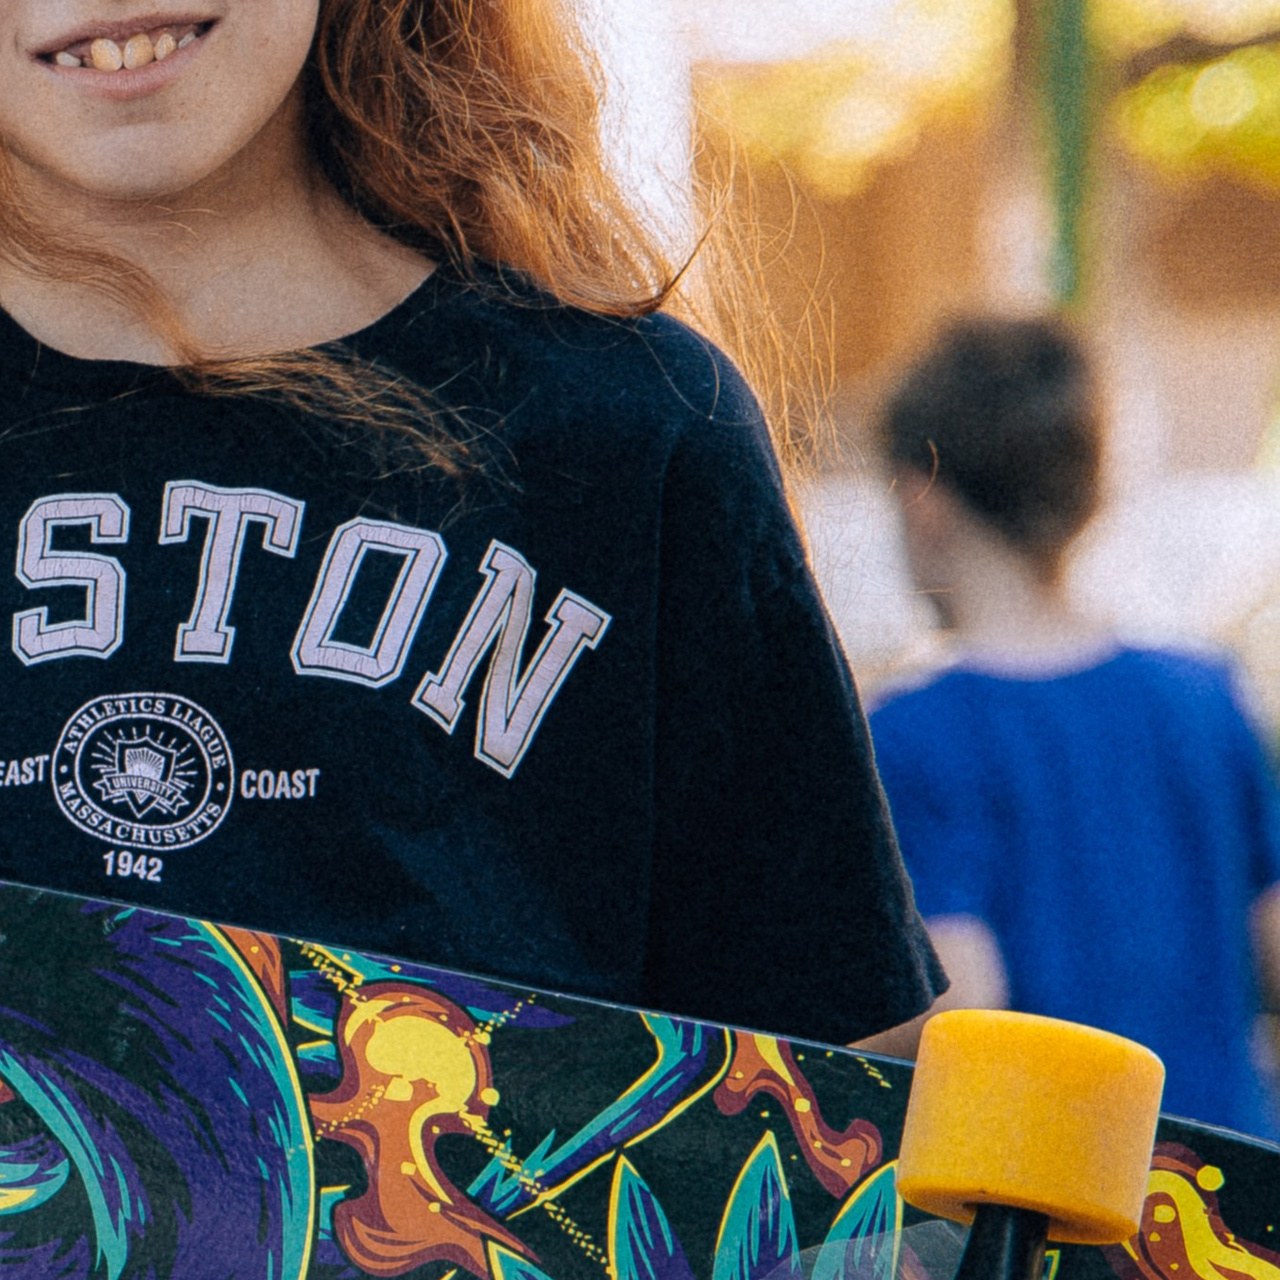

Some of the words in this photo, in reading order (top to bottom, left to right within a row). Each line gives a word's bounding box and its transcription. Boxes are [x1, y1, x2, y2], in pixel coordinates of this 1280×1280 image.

[63, 699, 166, 755] ATHLETICS
[112, 776, 173, 798] UNIVERSITY
[240, 768, 321, 800] COAST
[59, 780, 222, 845] MASSACHUSETTS
[102, 850, 163, 882] 1942
